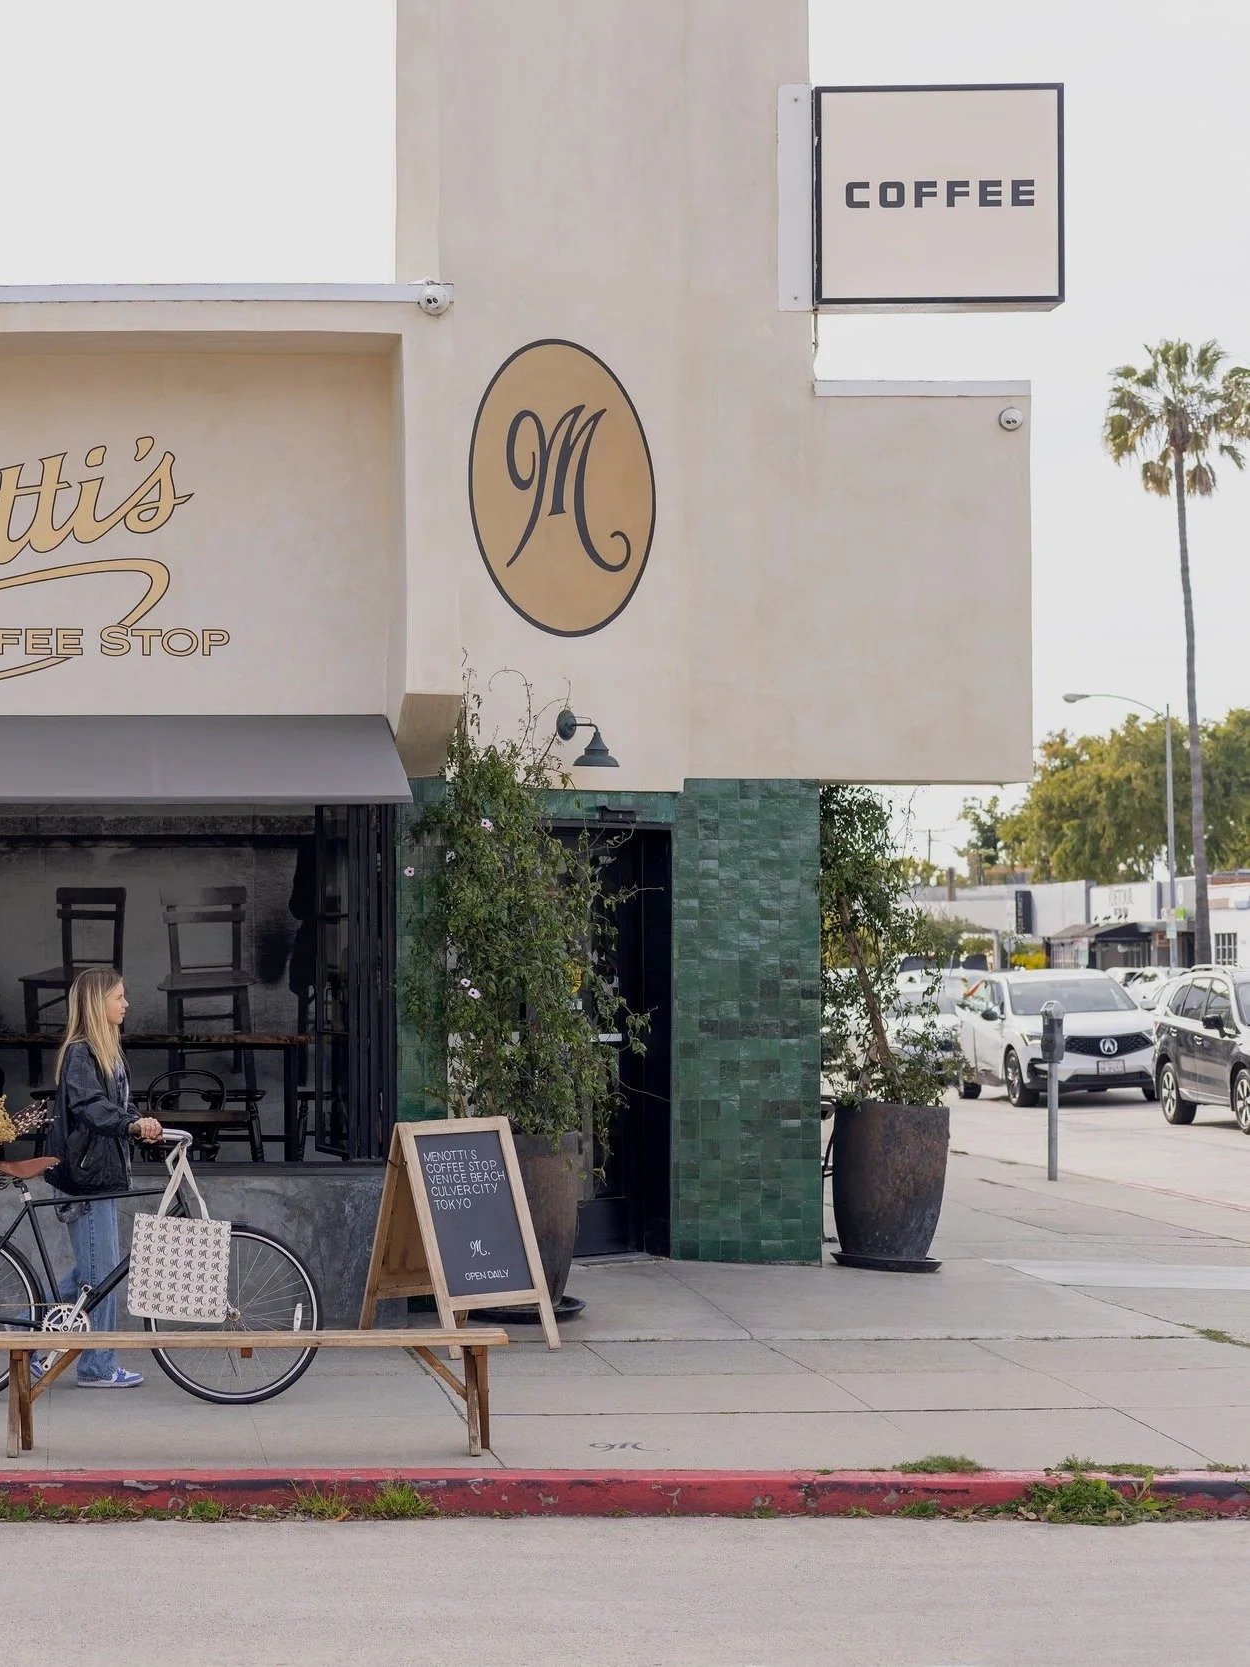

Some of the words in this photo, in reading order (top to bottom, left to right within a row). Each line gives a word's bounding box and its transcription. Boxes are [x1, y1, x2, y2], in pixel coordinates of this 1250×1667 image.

[845, 180, 1035, 208] COFFEE
[506, 404, 631, 573] M
[99, 624, 230, 656] STOP
[423, 1150, 477, 1162] MENOTTI'S
[426, 1162, 465, 1173] COFFEE
[468, 1160, 497, 1172] STOP
[428, 1173, 468, 1185] VENICE
[470, 1171, 506, 1182] BEACH
[431, 1185, 471, 1197] CULVER
[471, 1183, 498, 1195] CITY
[434, 1198, 472, 1210] TOKYO
[465, 1272, 487, 1281] OPEN
[488, 1269, 509, 1280] DAILY
